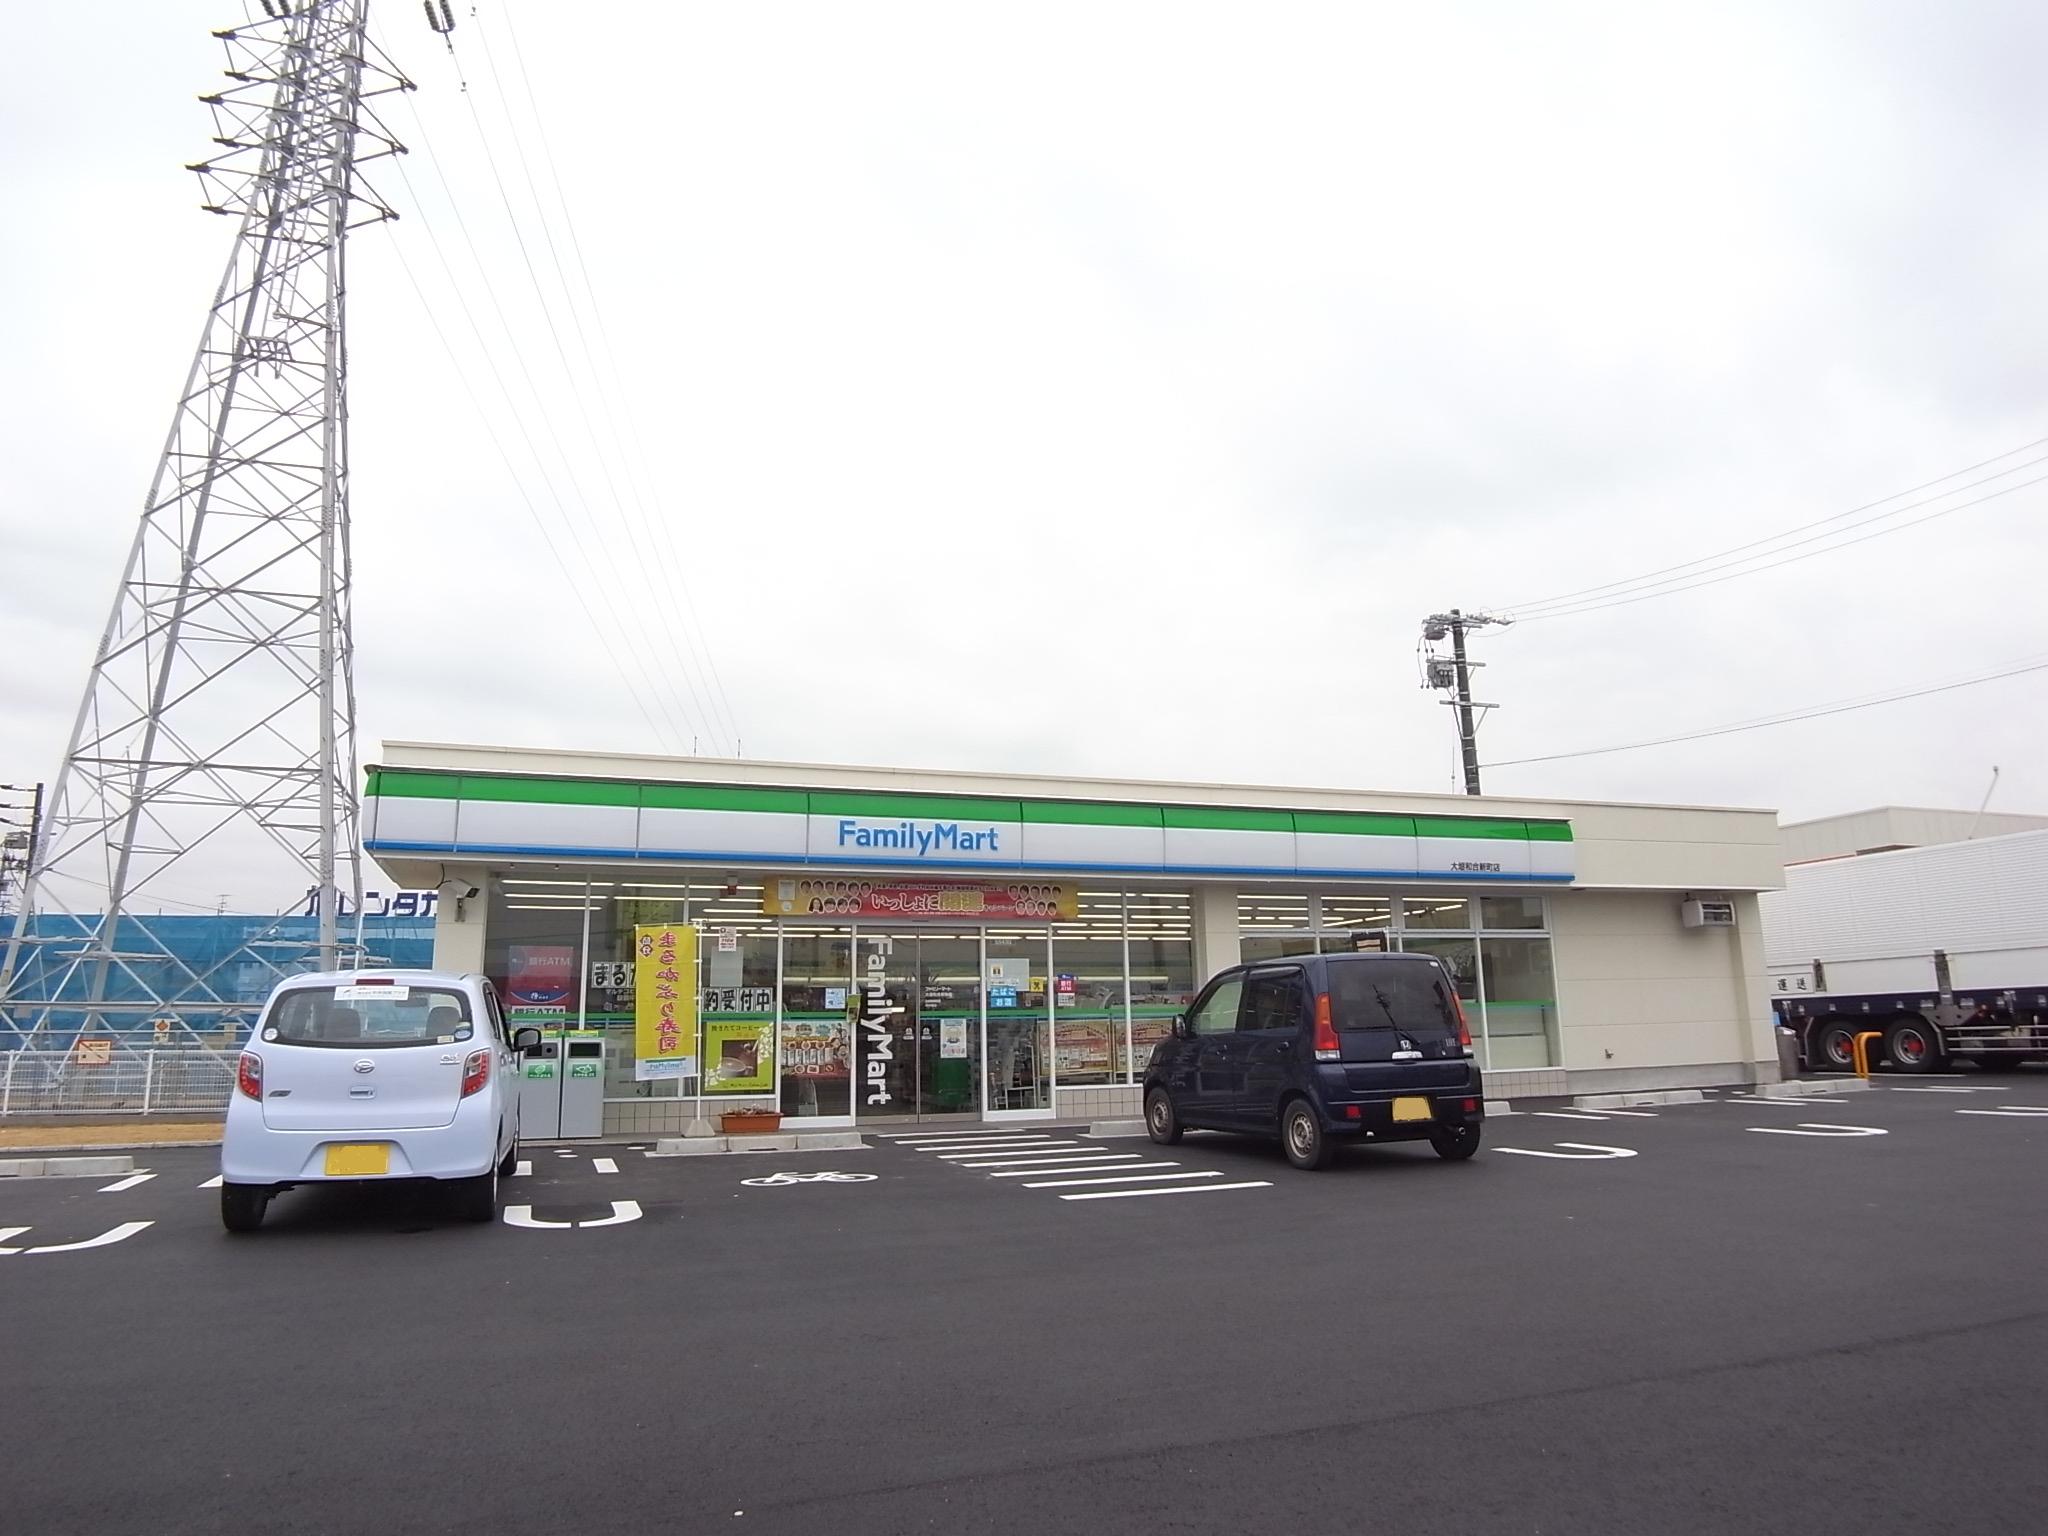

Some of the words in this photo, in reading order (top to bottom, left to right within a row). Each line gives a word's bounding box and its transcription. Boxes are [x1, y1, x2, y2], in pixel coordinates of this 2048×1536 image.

[839, 820, 998, 856] FamilyMart
[703, 990, 771, 1011] 約受付中
[860, 938, 893, 1105] FamilyMart
